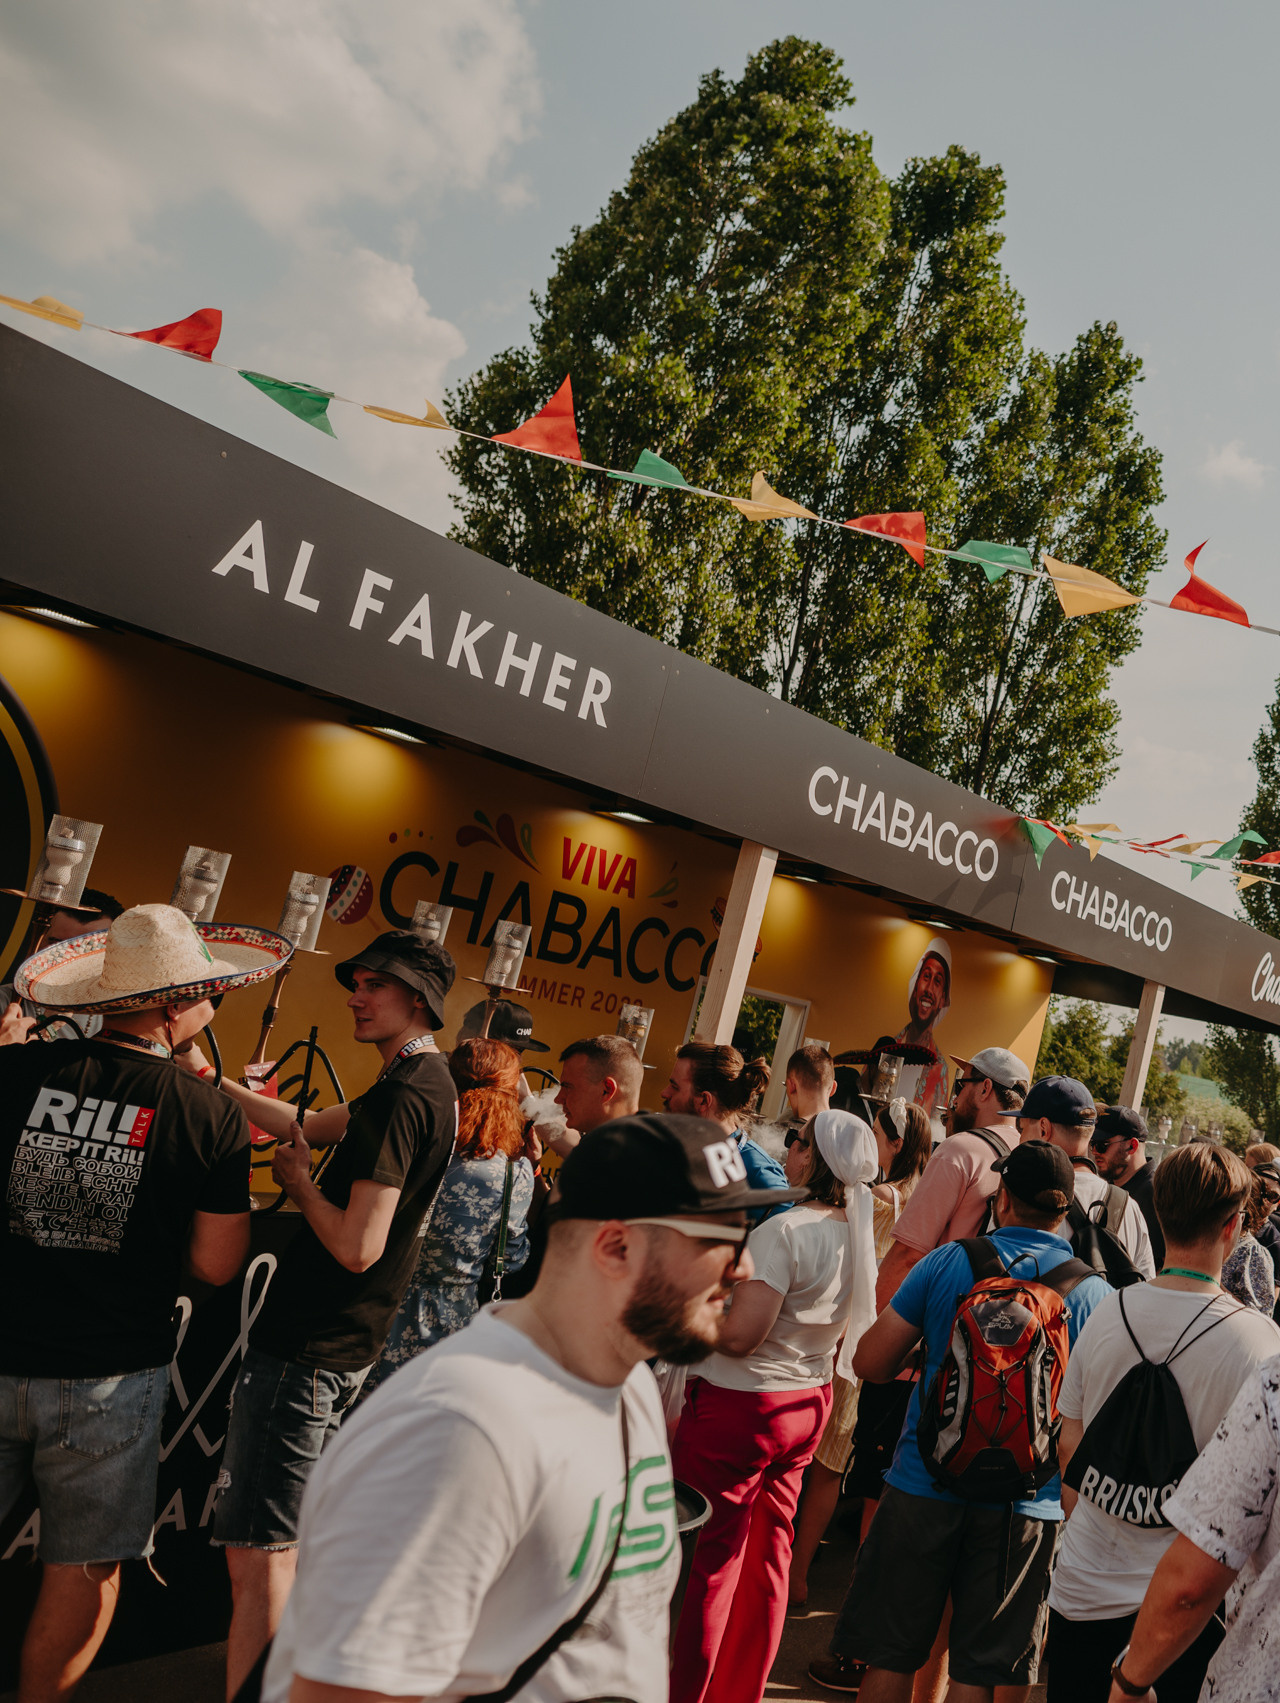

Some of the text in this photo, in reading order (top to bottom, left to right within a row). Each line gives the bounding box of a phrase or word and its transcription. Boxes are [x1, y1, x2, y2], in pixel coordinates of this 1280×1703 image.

[211, 519, 612, 728] AL FAKHER
[807, 765, 999, 882] CHABACCO
[561, 836, 638, 900] VIVA
[1050, 870, 1173, 952] CHABACCO
[500, 974, 586, 1009] MMER
[19, 1129, 81, 1153] KEEP
[80, 1141, 105, 1158] IT
[131, 1111, 151, 1144] TALK
[14, 1145, 70, 1168] БУДЬ
[9, 1174, 135, 1208] RESTE VRAI
[11, 1159, 139, 1194] BLEIB ECHT
